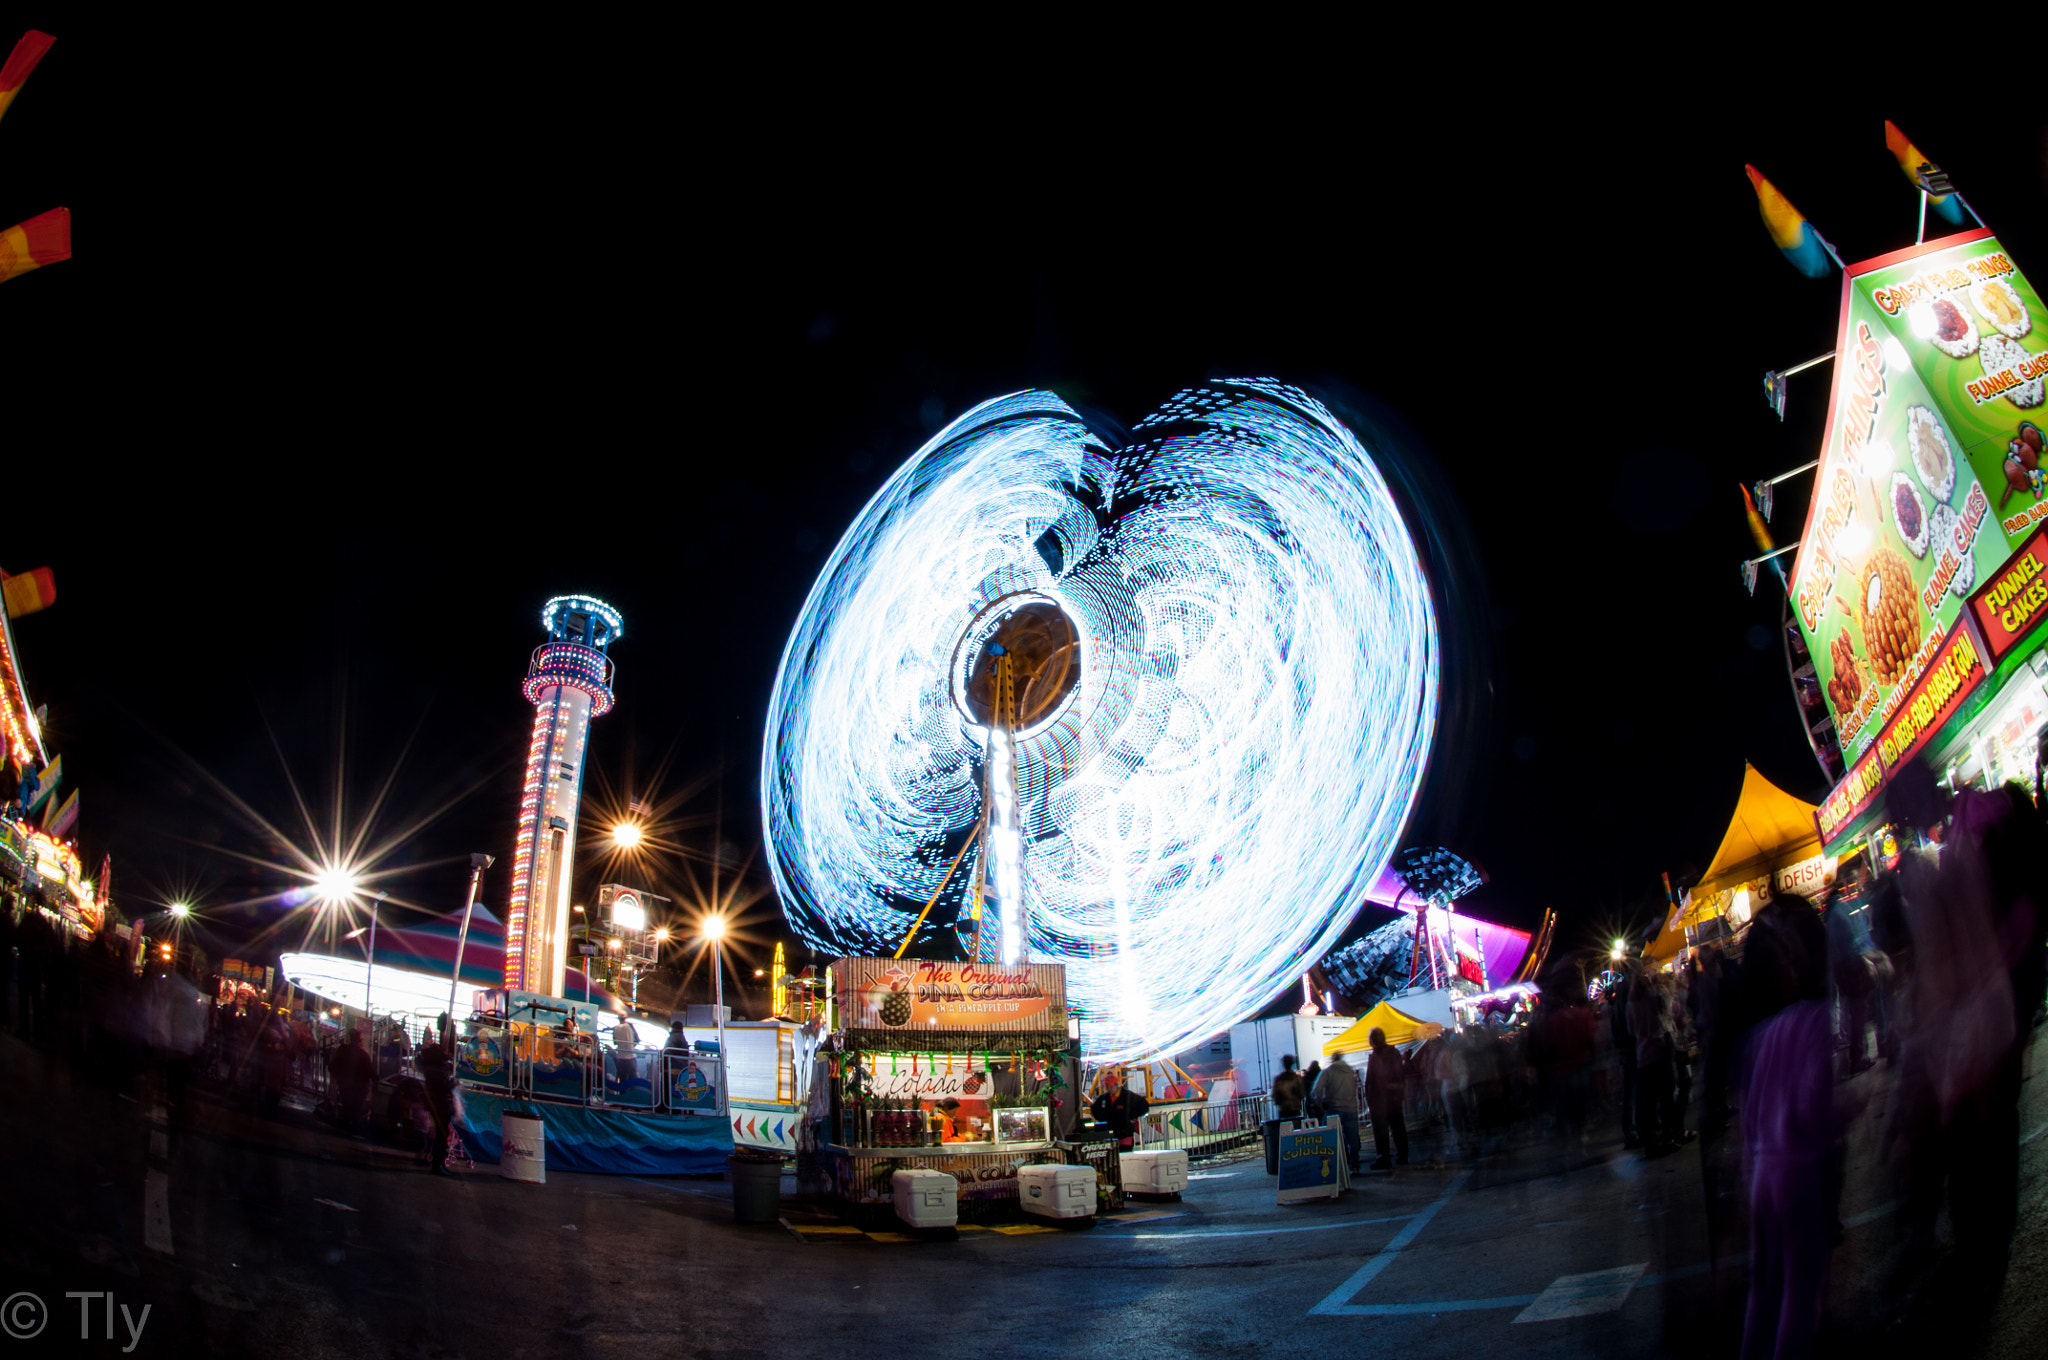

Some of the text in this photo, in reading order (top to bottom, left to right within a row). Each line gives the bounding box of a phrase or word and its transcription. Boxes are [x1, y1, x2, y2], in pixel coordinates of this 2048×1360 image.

[1874, 253, 2015, 314] CRAZY FRIED THINGS
[1967, 368, 2024, 404] FUNNEL
[1799, 322, 1887, 633] CRAZY FRIED THINGS
[2003, 513, 2031, 535] FRIED
[1923, 483, 1988, 618] FUNNEL CAKES
[1985, 552, 2047, 617] FUNNEL
[2001, 578, 2048, 633] CAKES
[1910, 692, 1936, 734] FRIED
[1927, 655, 1963, 712] BUBBLE
[1953, 630, 1982, 680] GUM
[920, 962, 1031, 985] The Original
[917, 980, 1045, 1003] PINA COLADA
[949, 1004, 955, 1013] A
[1004, 1002, 1020, 1012] CUP
[889, 1069, 962, 1095] Colada
[1081, 1143, 1112, 1152] ORDER
[1295, 1135, 1323, 1147] Pina
[1086, 1151, 1108, 1159] HERE
[1282, 1145, 1335, 1161] Coladas
[977, 1164, 1018, 1181] COLA
